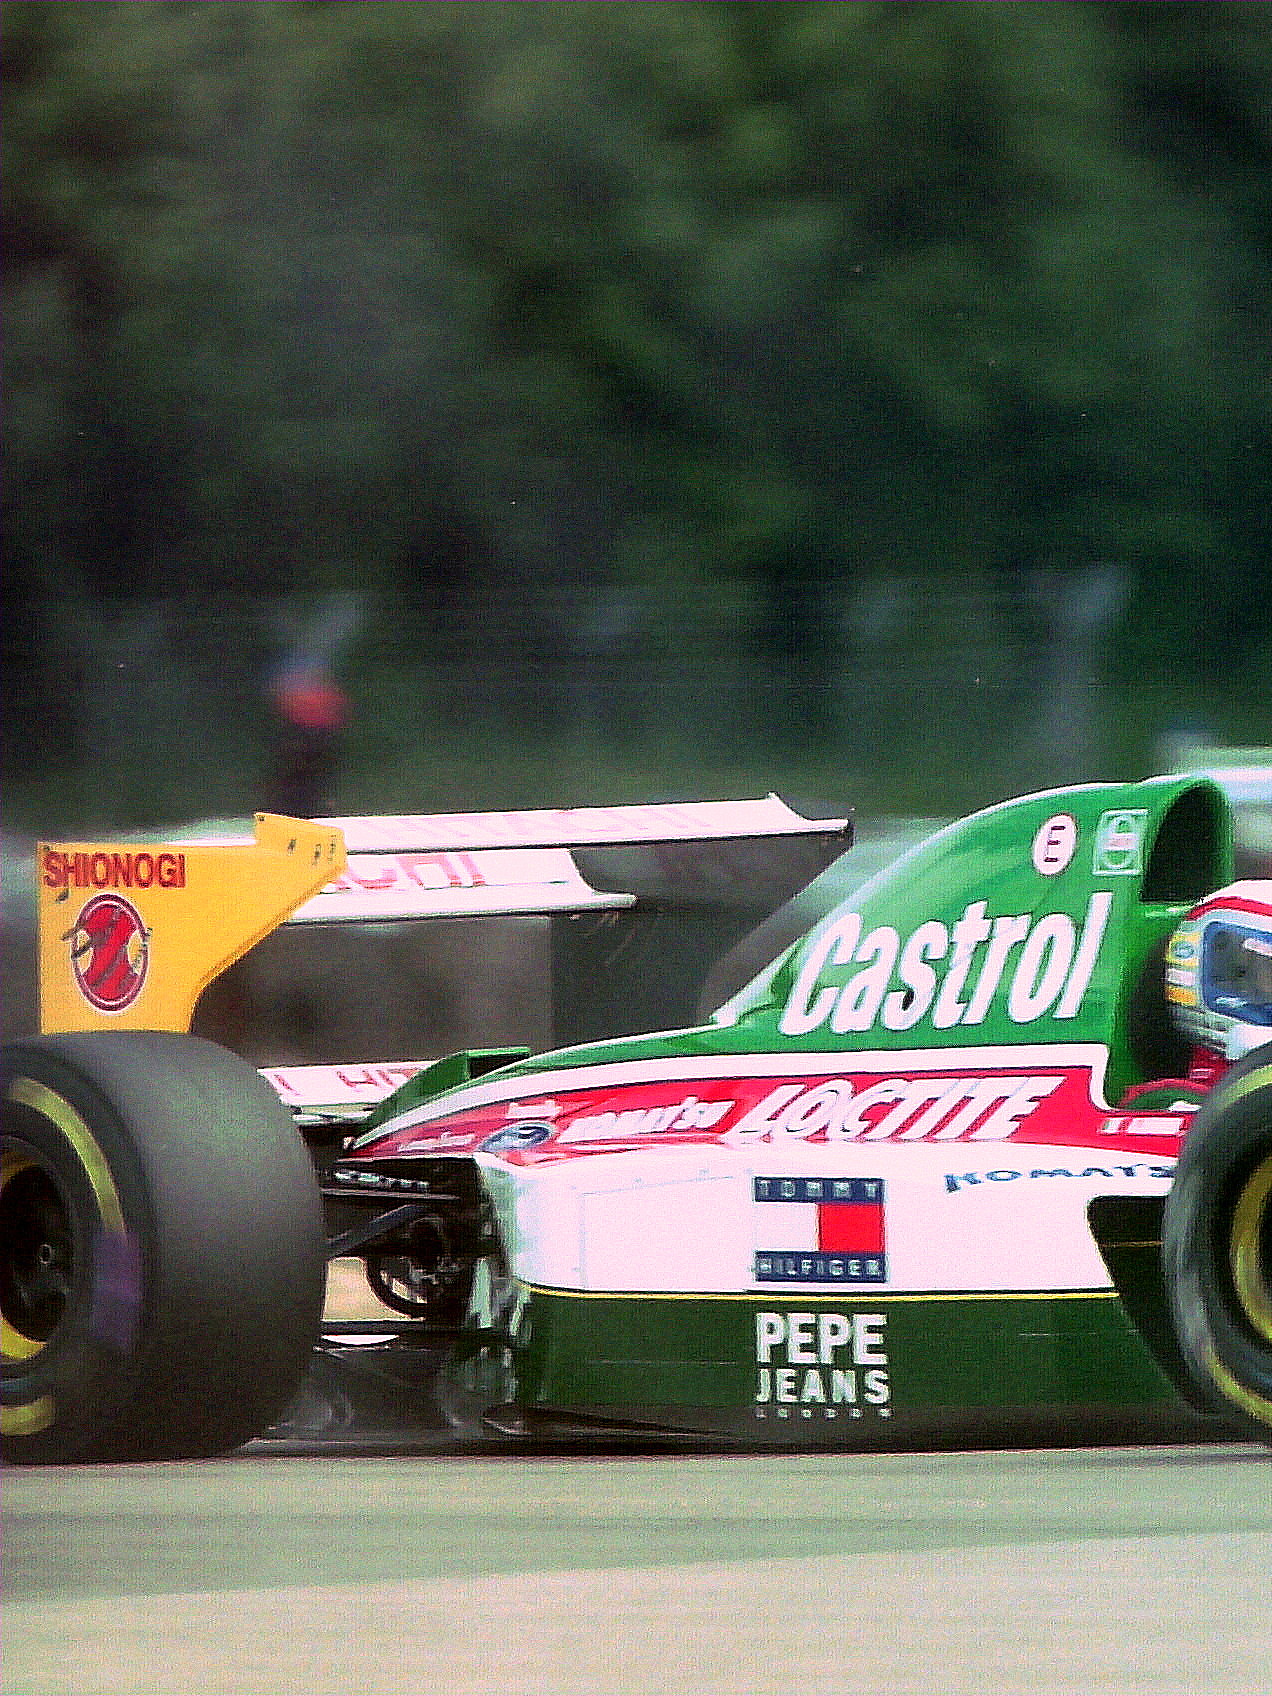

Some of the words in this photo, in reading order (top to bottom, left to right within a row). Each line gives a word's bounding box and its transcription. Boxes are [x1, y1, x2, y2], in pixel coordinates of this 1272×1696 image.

[43, 851, 186, 889] SHIONOGI
[778, 891, 1113, 1037] Castrol
[724, 1076, 1068, 1142] LOCTITE
[944, 1163, 1176, 1193] KOMATS
[756, 1258, 882, 1276] HILFIGER
[756, 1312, 888, 1364] PEPE
[756, 1368, 890, 1403] JEANS
